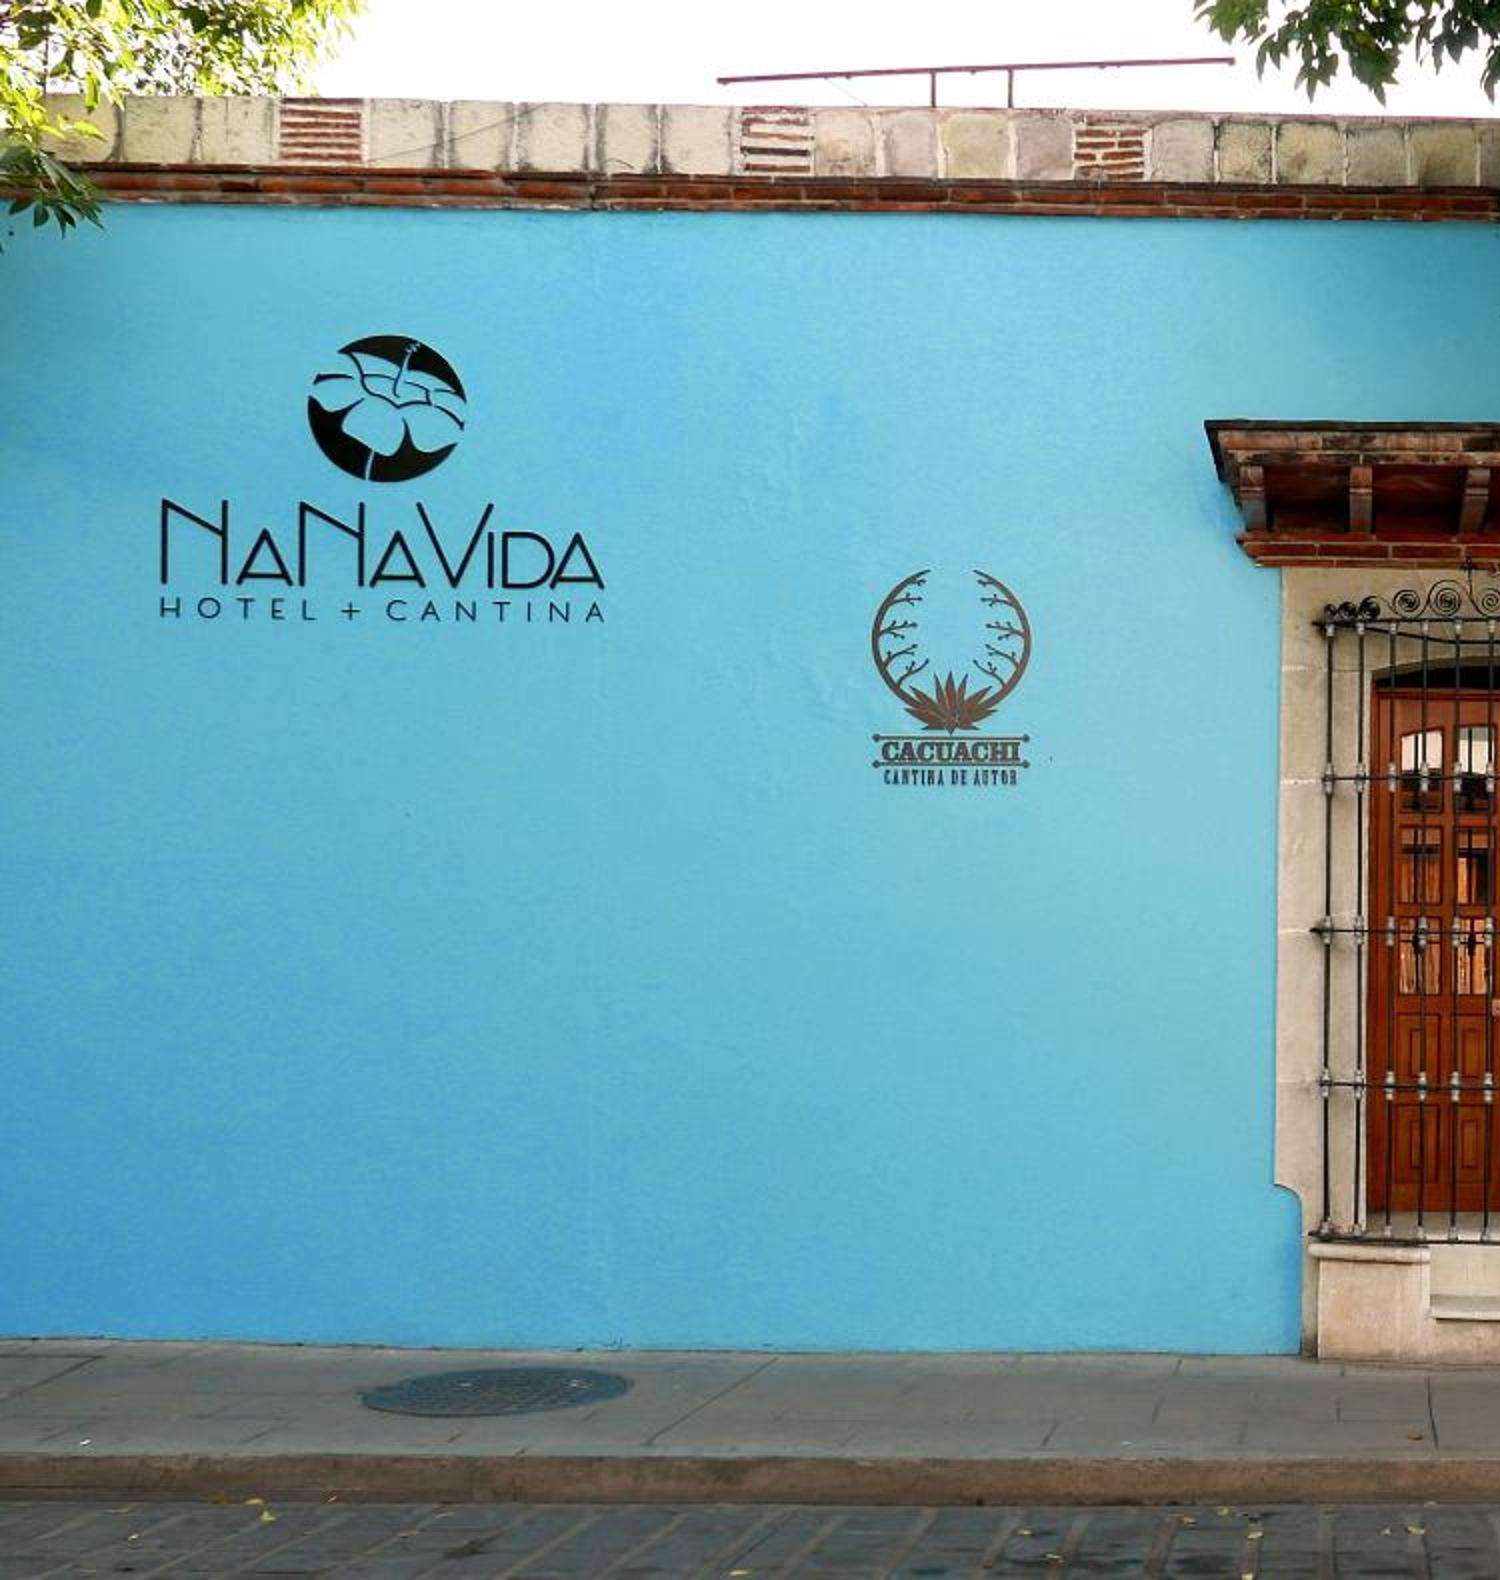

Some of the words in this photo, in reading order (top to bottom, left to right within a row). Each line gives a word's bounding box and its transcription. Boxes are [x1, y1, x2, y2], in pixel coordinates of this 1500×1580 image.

[160, 597, 317, 621] HOTEL
[341, 601, 361, 621] +
[385, 599, 605, 623] CANTINA
[881, 741, 1021, 761] CACUACHI
[884, 768, 945, 786] CANTINA
[951, 768, 968, 786] DE
[973, 768, 1017, 786] AUTOR
